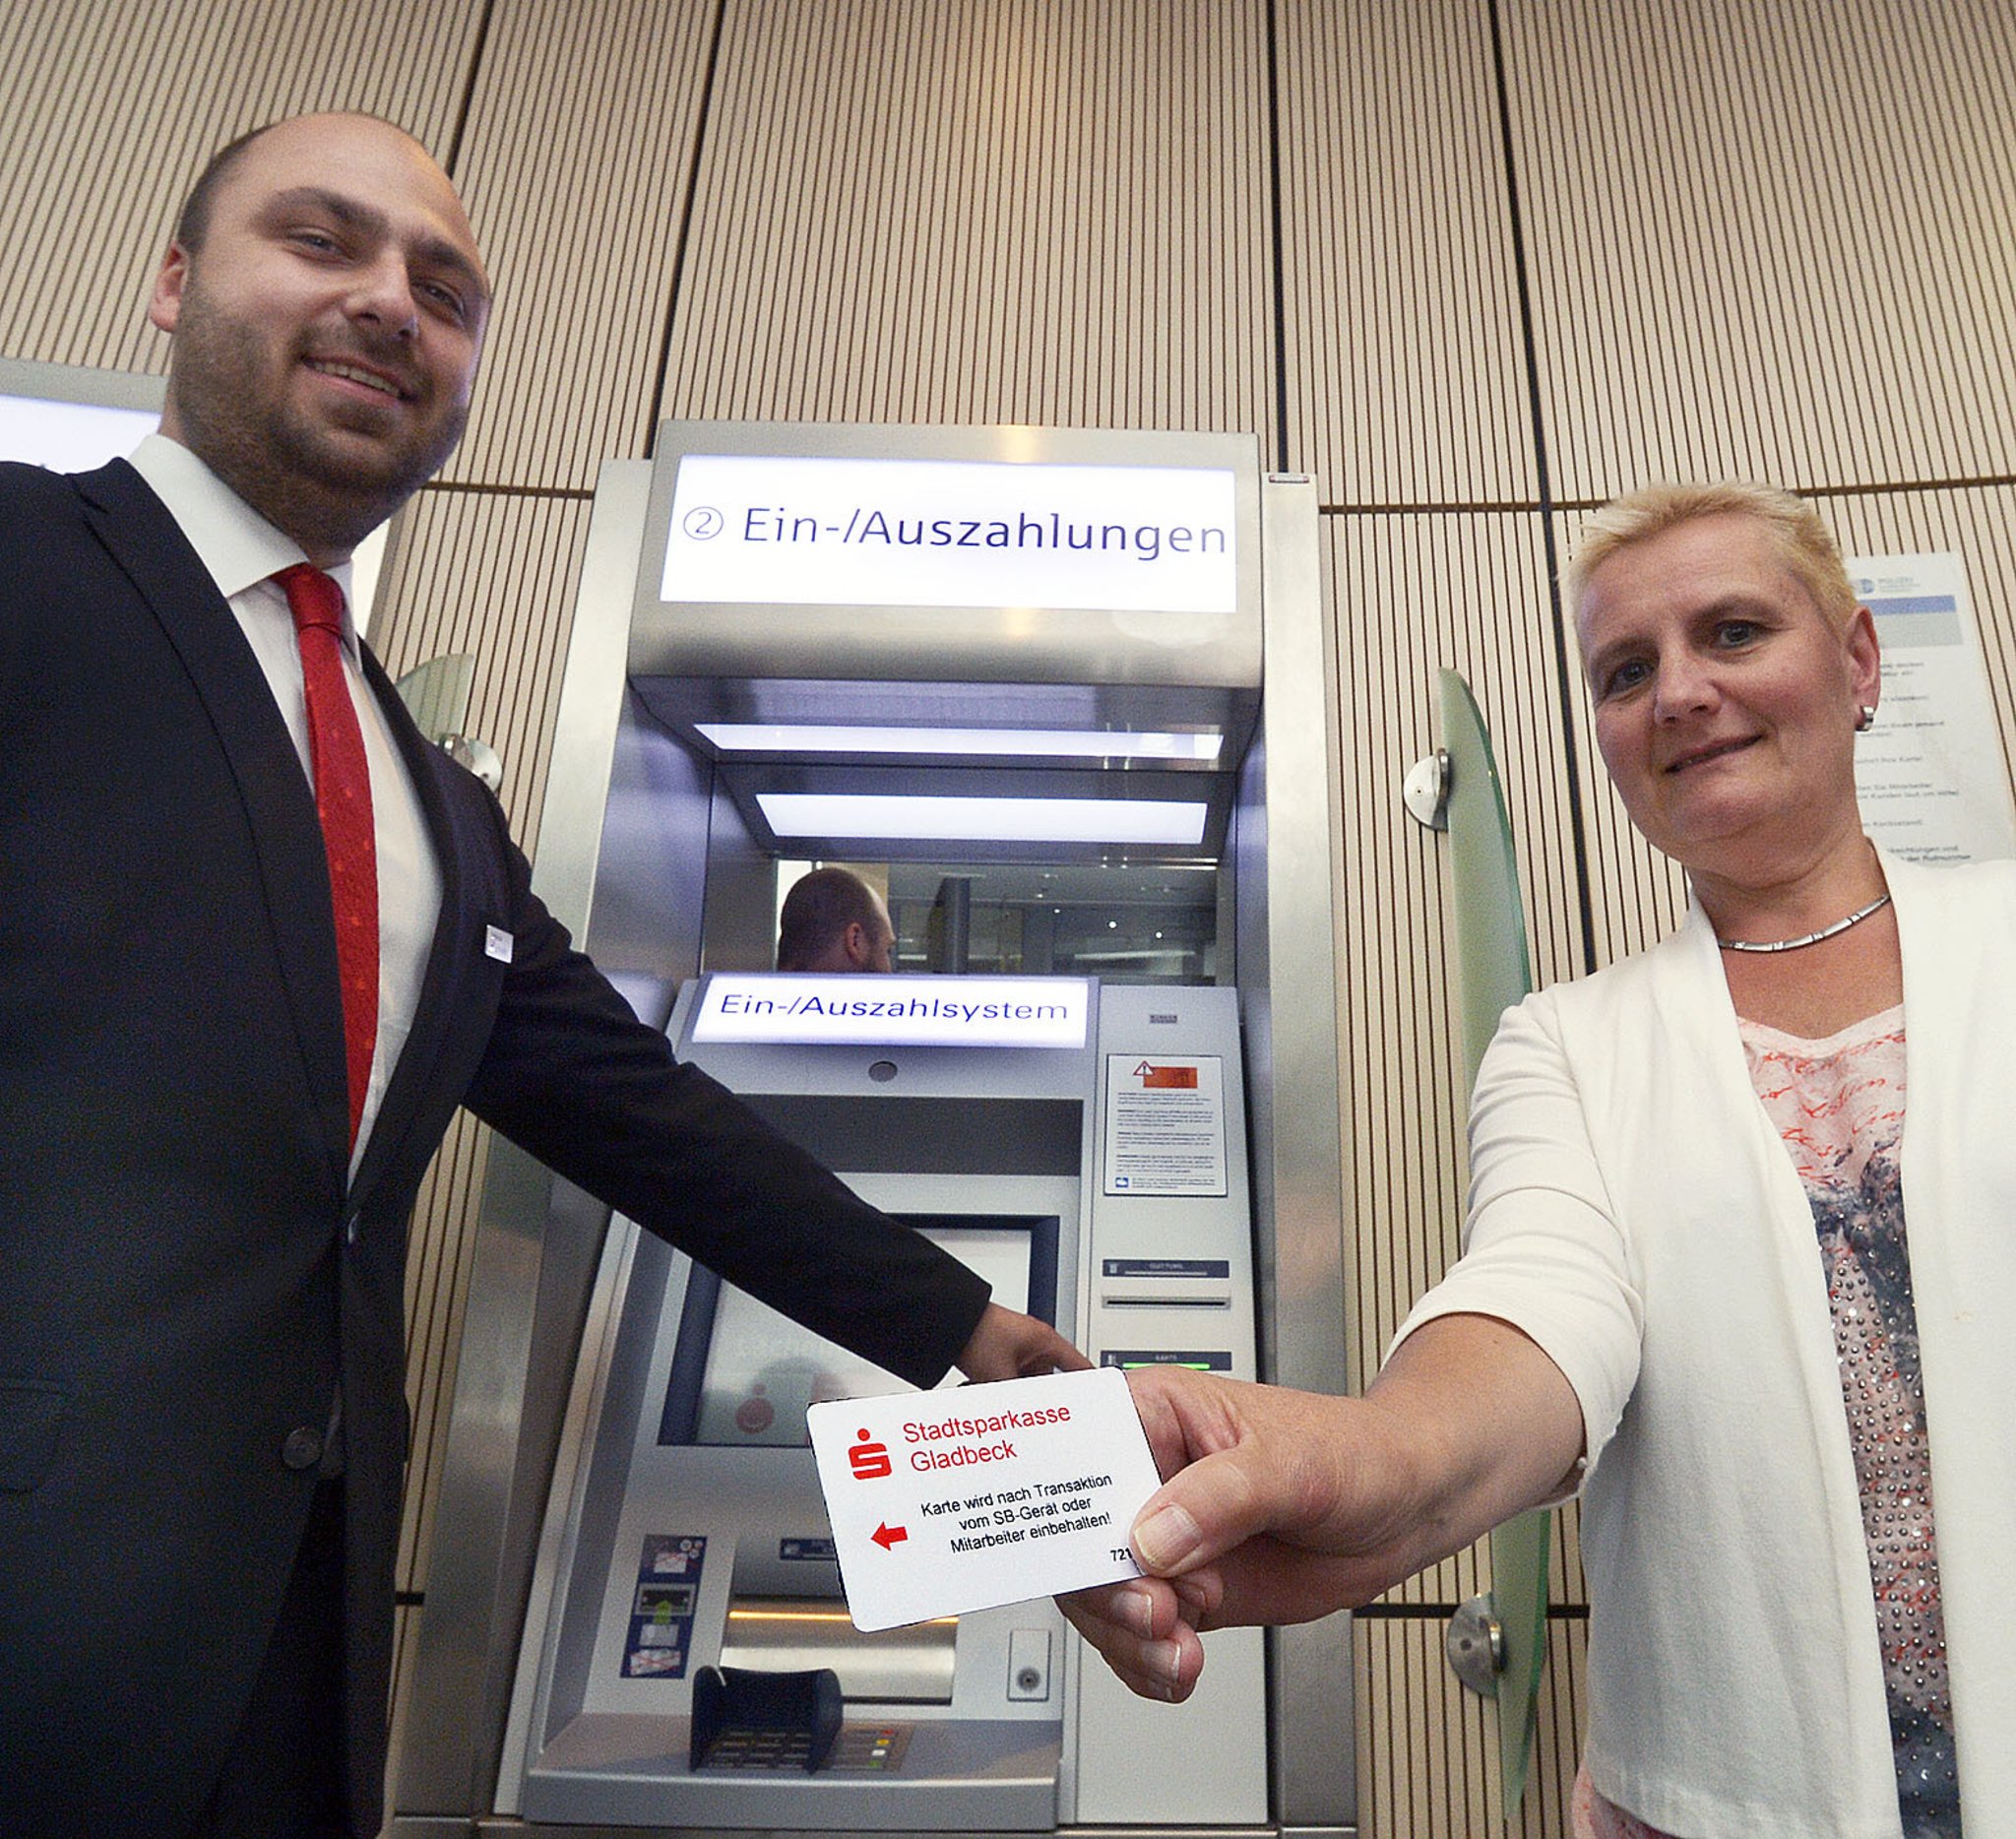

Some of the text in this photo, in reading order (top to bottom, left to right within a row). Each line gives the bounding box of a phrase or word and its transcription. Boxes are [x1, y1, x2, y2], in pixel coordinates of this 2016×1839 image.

[743, 507, 1227, 561] Ein-/Auszahlungen
[720, 993, 1068, 1024] Ein-/Auszahlsystem
[903, 1406, 1072, 1442] Stadtsparkasse
[911, 1439, 1018, 1472] Gladbeck
[921, 1474, 1113, 1517] Karte wird nach Transaktion
[959, 1496, 1093, 1531] vom SB-Gerät oder
[950, 1511, 1113, 1554] Mitarbeiter einbehalten!
